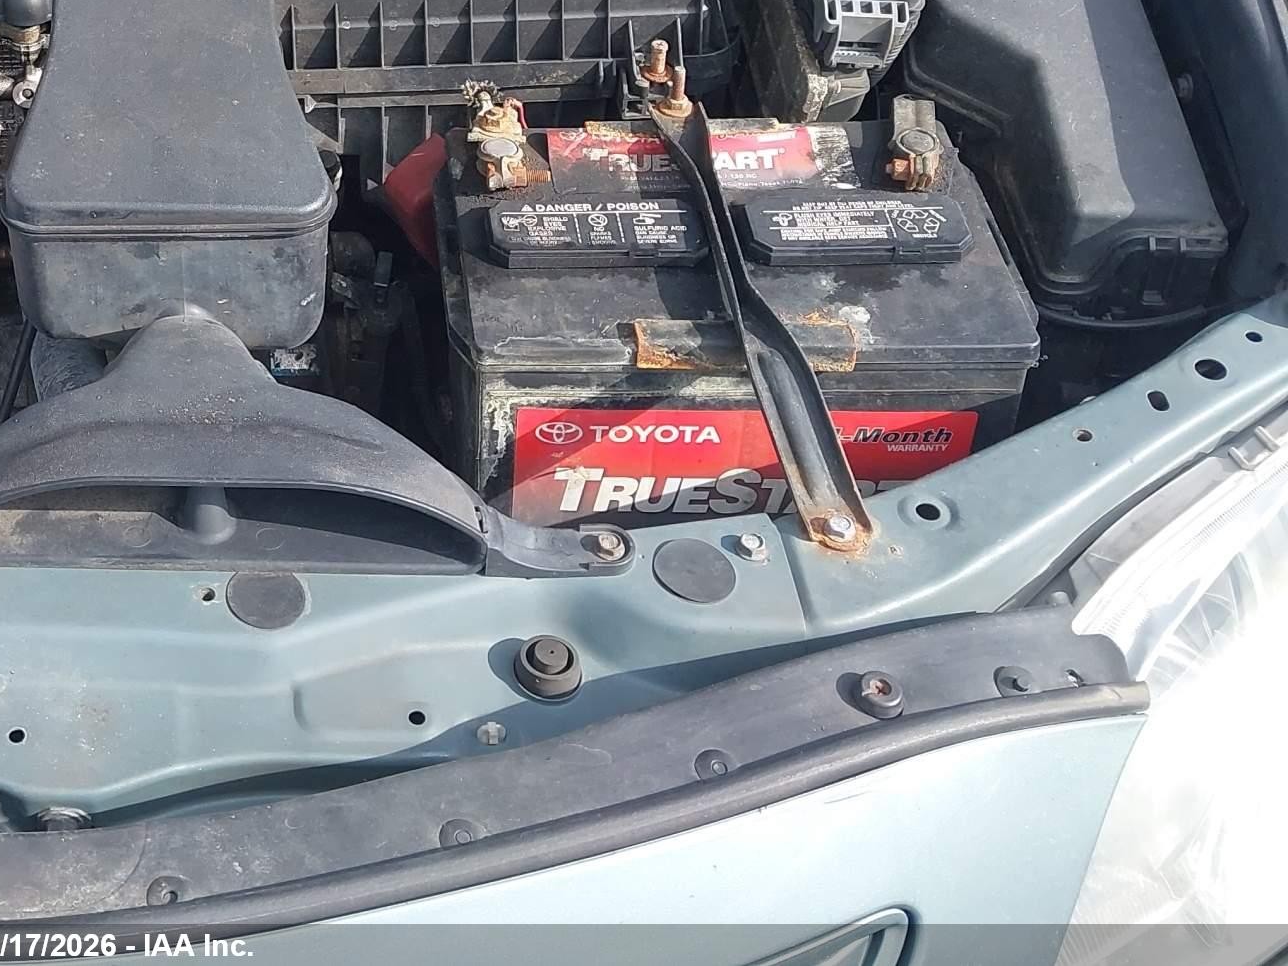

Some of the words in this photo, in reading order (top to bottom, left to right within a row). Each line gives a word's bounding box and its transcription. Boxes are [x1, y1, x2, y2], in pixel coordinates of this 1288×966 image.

[535, 203, 592, 212] DANGER
[606, 201, 660, 211] POISON
[589, 424, 721, 443] TOYOTA
[887, 443, 949, 452] WARRANTY
